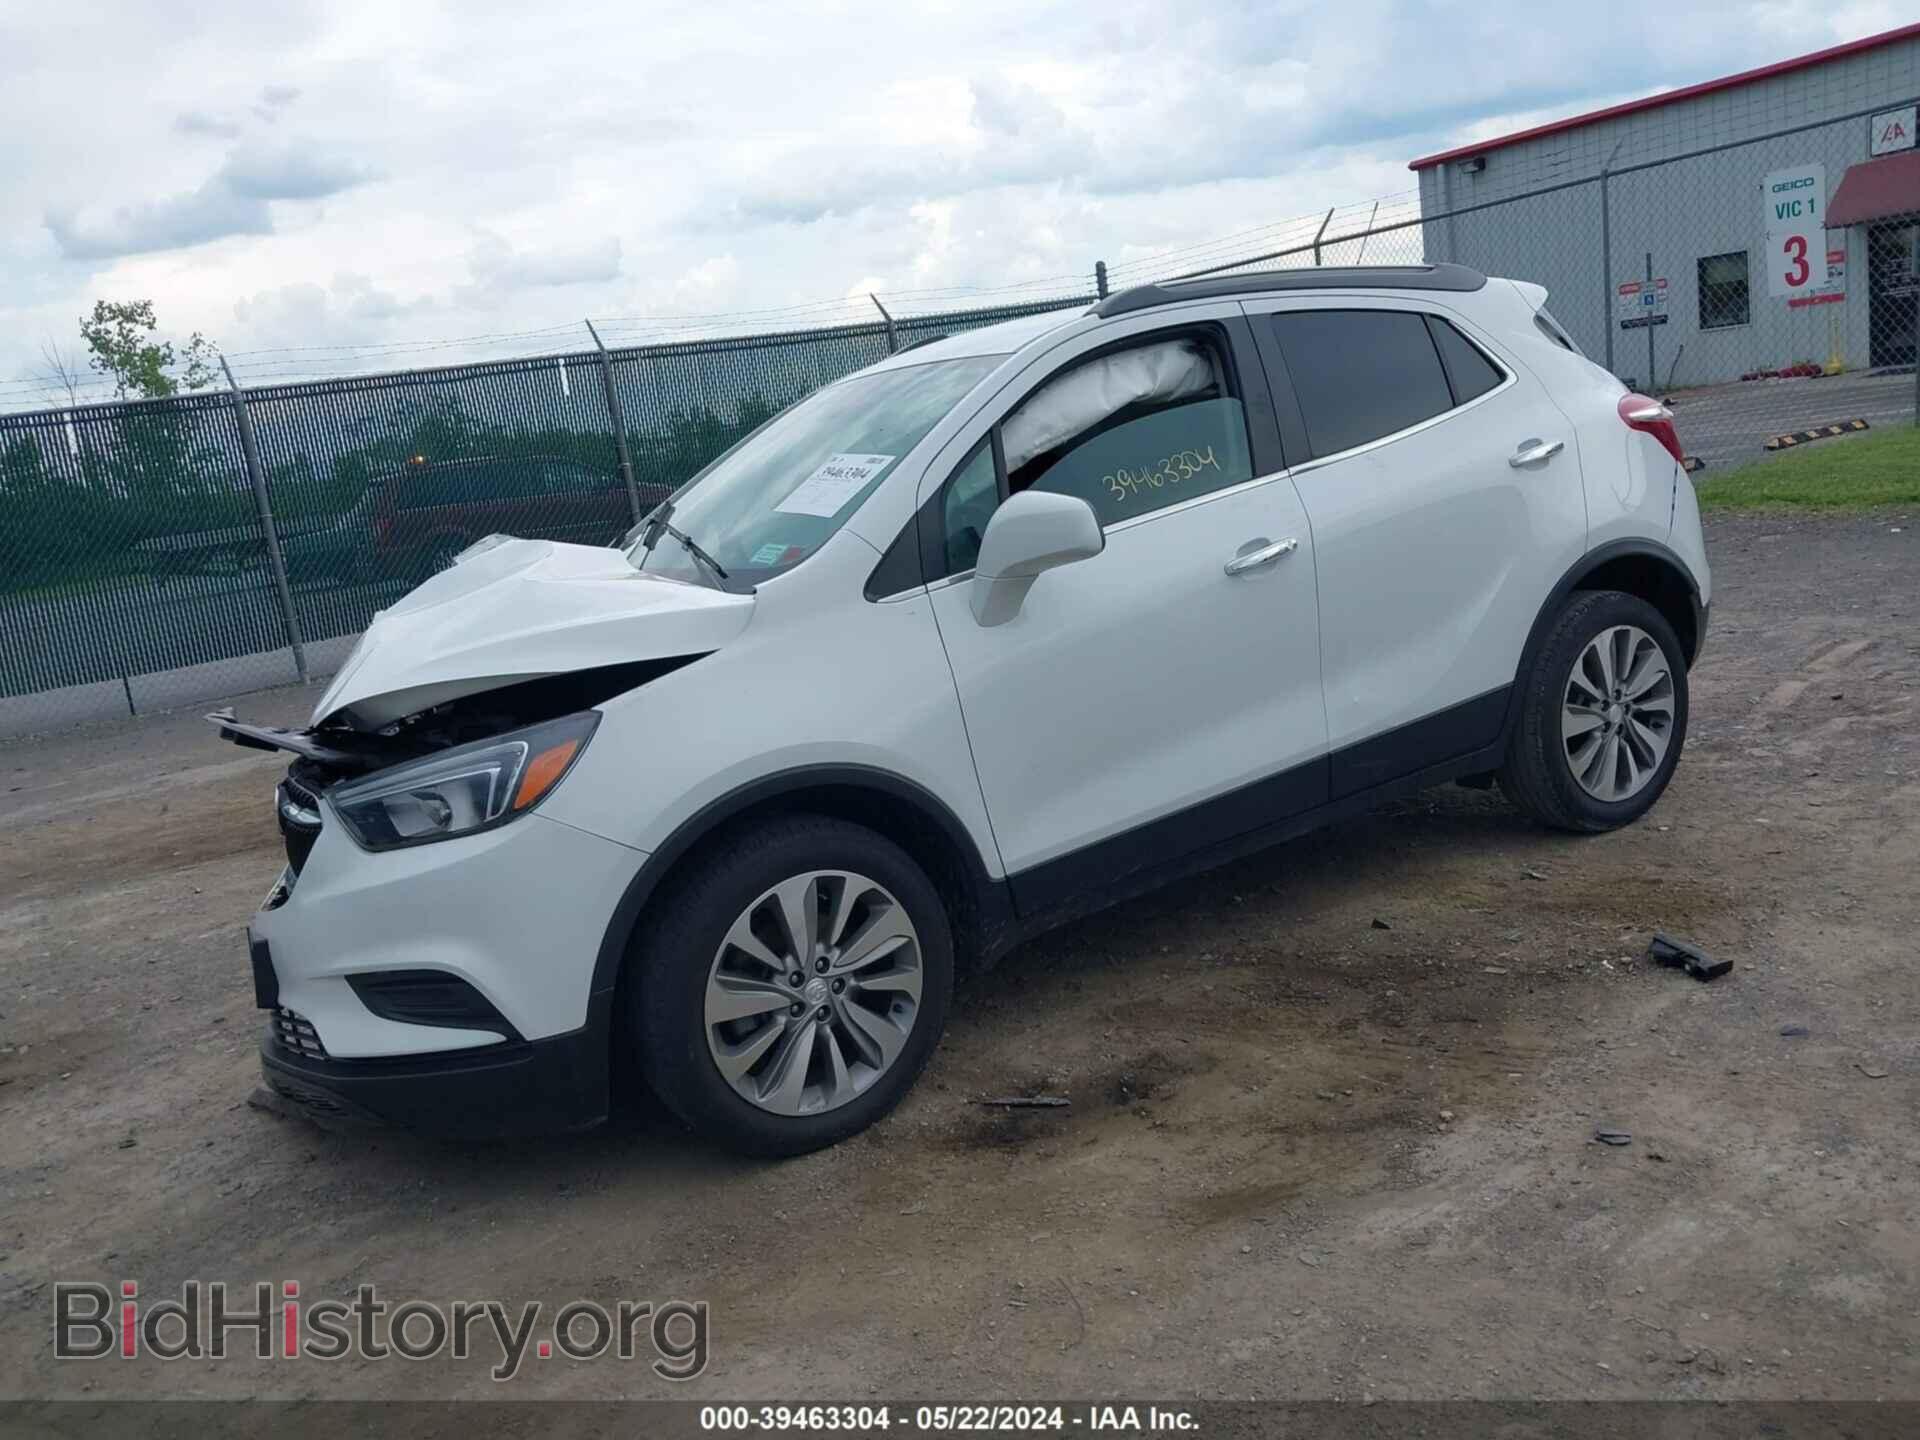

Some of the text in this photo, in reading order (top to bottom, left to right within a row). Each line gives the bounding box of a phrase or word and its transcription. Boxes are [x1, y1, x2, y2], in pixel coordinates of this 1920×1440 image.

[1772, 177, 1815, 193] GEICO
[1775, 197, 1816, 220] VIC 1
[1783, 235, 1810, 287] 3
[1102, 445, 1221, 502] 39463304
